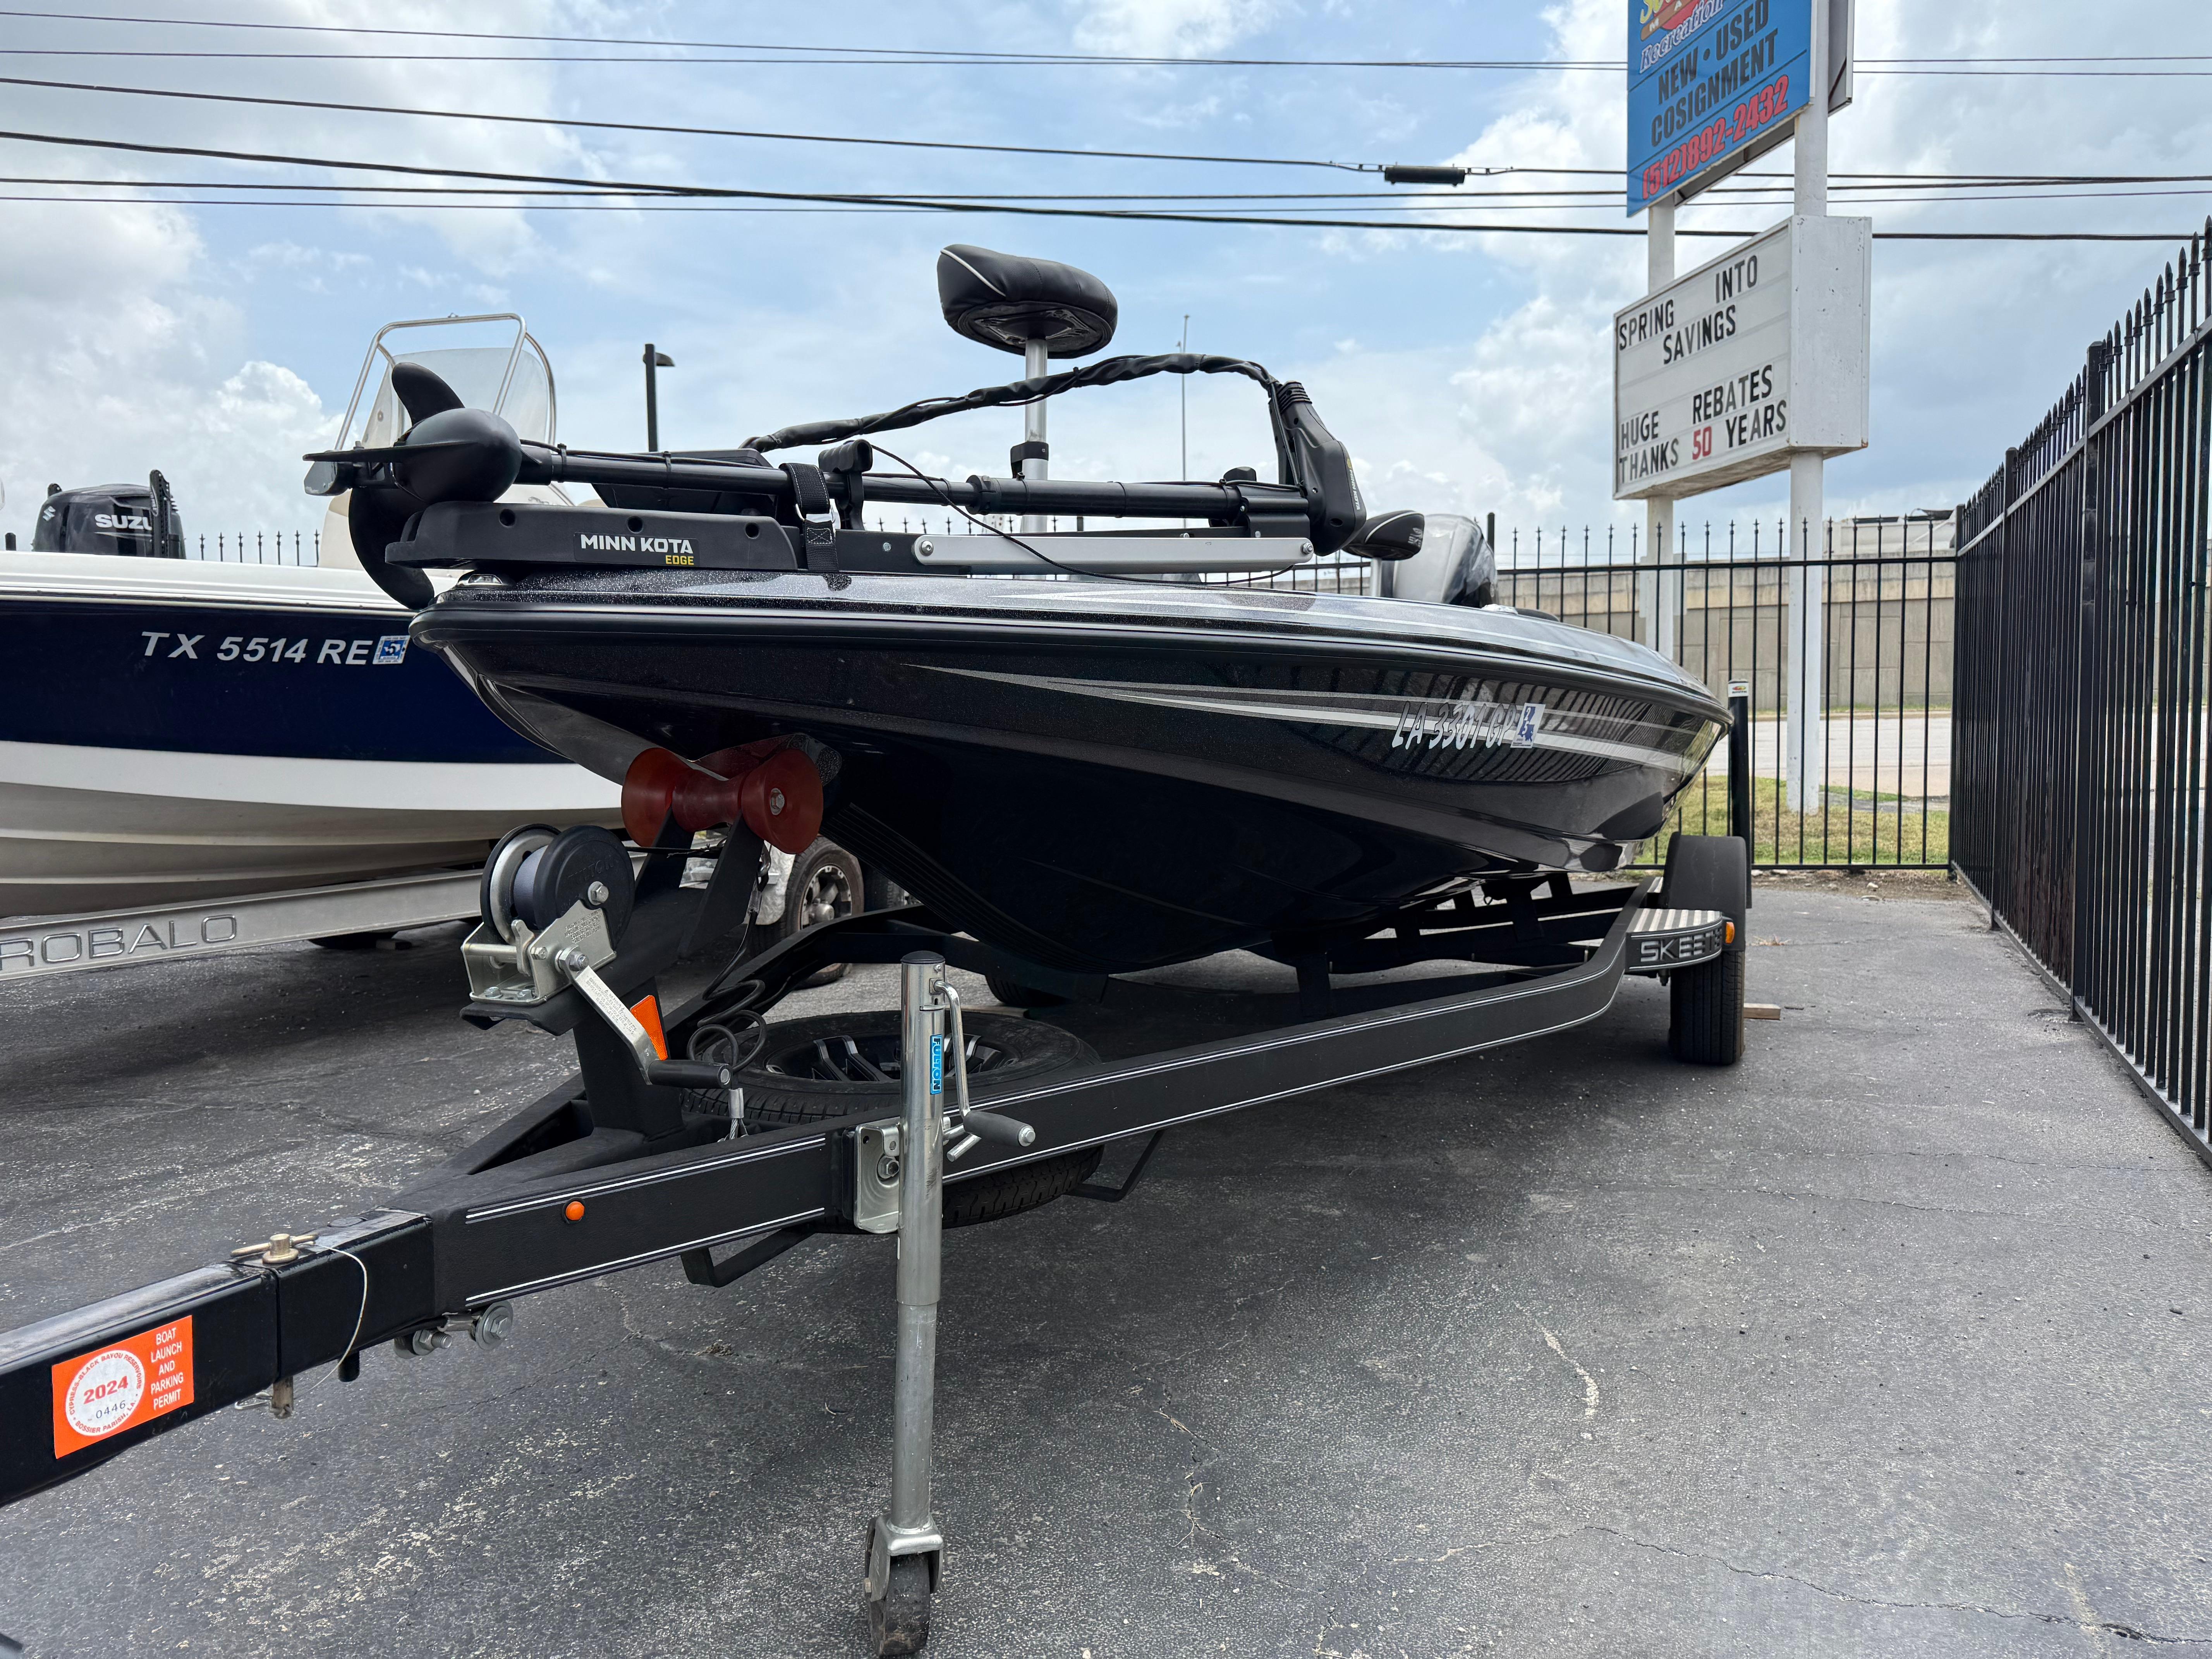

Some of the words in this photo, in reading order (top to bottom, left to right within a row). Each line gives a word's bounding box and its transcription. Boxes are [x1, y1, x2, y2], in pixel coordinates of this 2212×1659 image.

[1658, 46, 1698, 105] NEW
[1716, 0, 1769, 60] USED
[1651, 28, 1778, 147] COSIGNMENT
[1643, 75, 1789, 200] (512)892-2432
[1619, 299, 1674, 350] SPRING
[1715, 255, 1758, 303] INTO
[1663, 305, 1736, 364] SAVINGS
[1621, 410, 1659, 450] HUGE
[1692, 365, 1772, 424] REBATES
[1619, 438, 1679, 484] THANKS
[1692, 426, 1712, 460] 50
[1725, 400, 1787, 448] YEARS
[580, 534, 636, 551] MINN
[641, 538, 693, 554] KOTA
[665, 555, 694, 565] EDGE
[141, 631, 205, 659] TX
[216, 636, 309, 663] 5514
[317, 639, 374, 665] RE
[1392, 701, 1428, 750] LA
[1429, 702, 1487, 750] 3301
[1486, 702, 1516, 748] GP
[0, 914, 237, 970] ROBALO
[932, 1037, 941, 1091] FULTON
[151, 1341, 182, 1363] LAUNCH
[156, 1328, 177, 1345] BOAT
[101, 1352, 123, 1362] BAYOU
[124, 1354, 142, 1389] RESERVOIRS
[151, 1372, 184, 1395] PARKING
[158, 1360, 175, 1375] AND
[84, 1376, 129, 1405] 2024
[153, 1389, 181, 1411] PERMIT
[75, 1420, 101, 1433] BOSSIER
[96, 1400, 125, 1419] 0446
